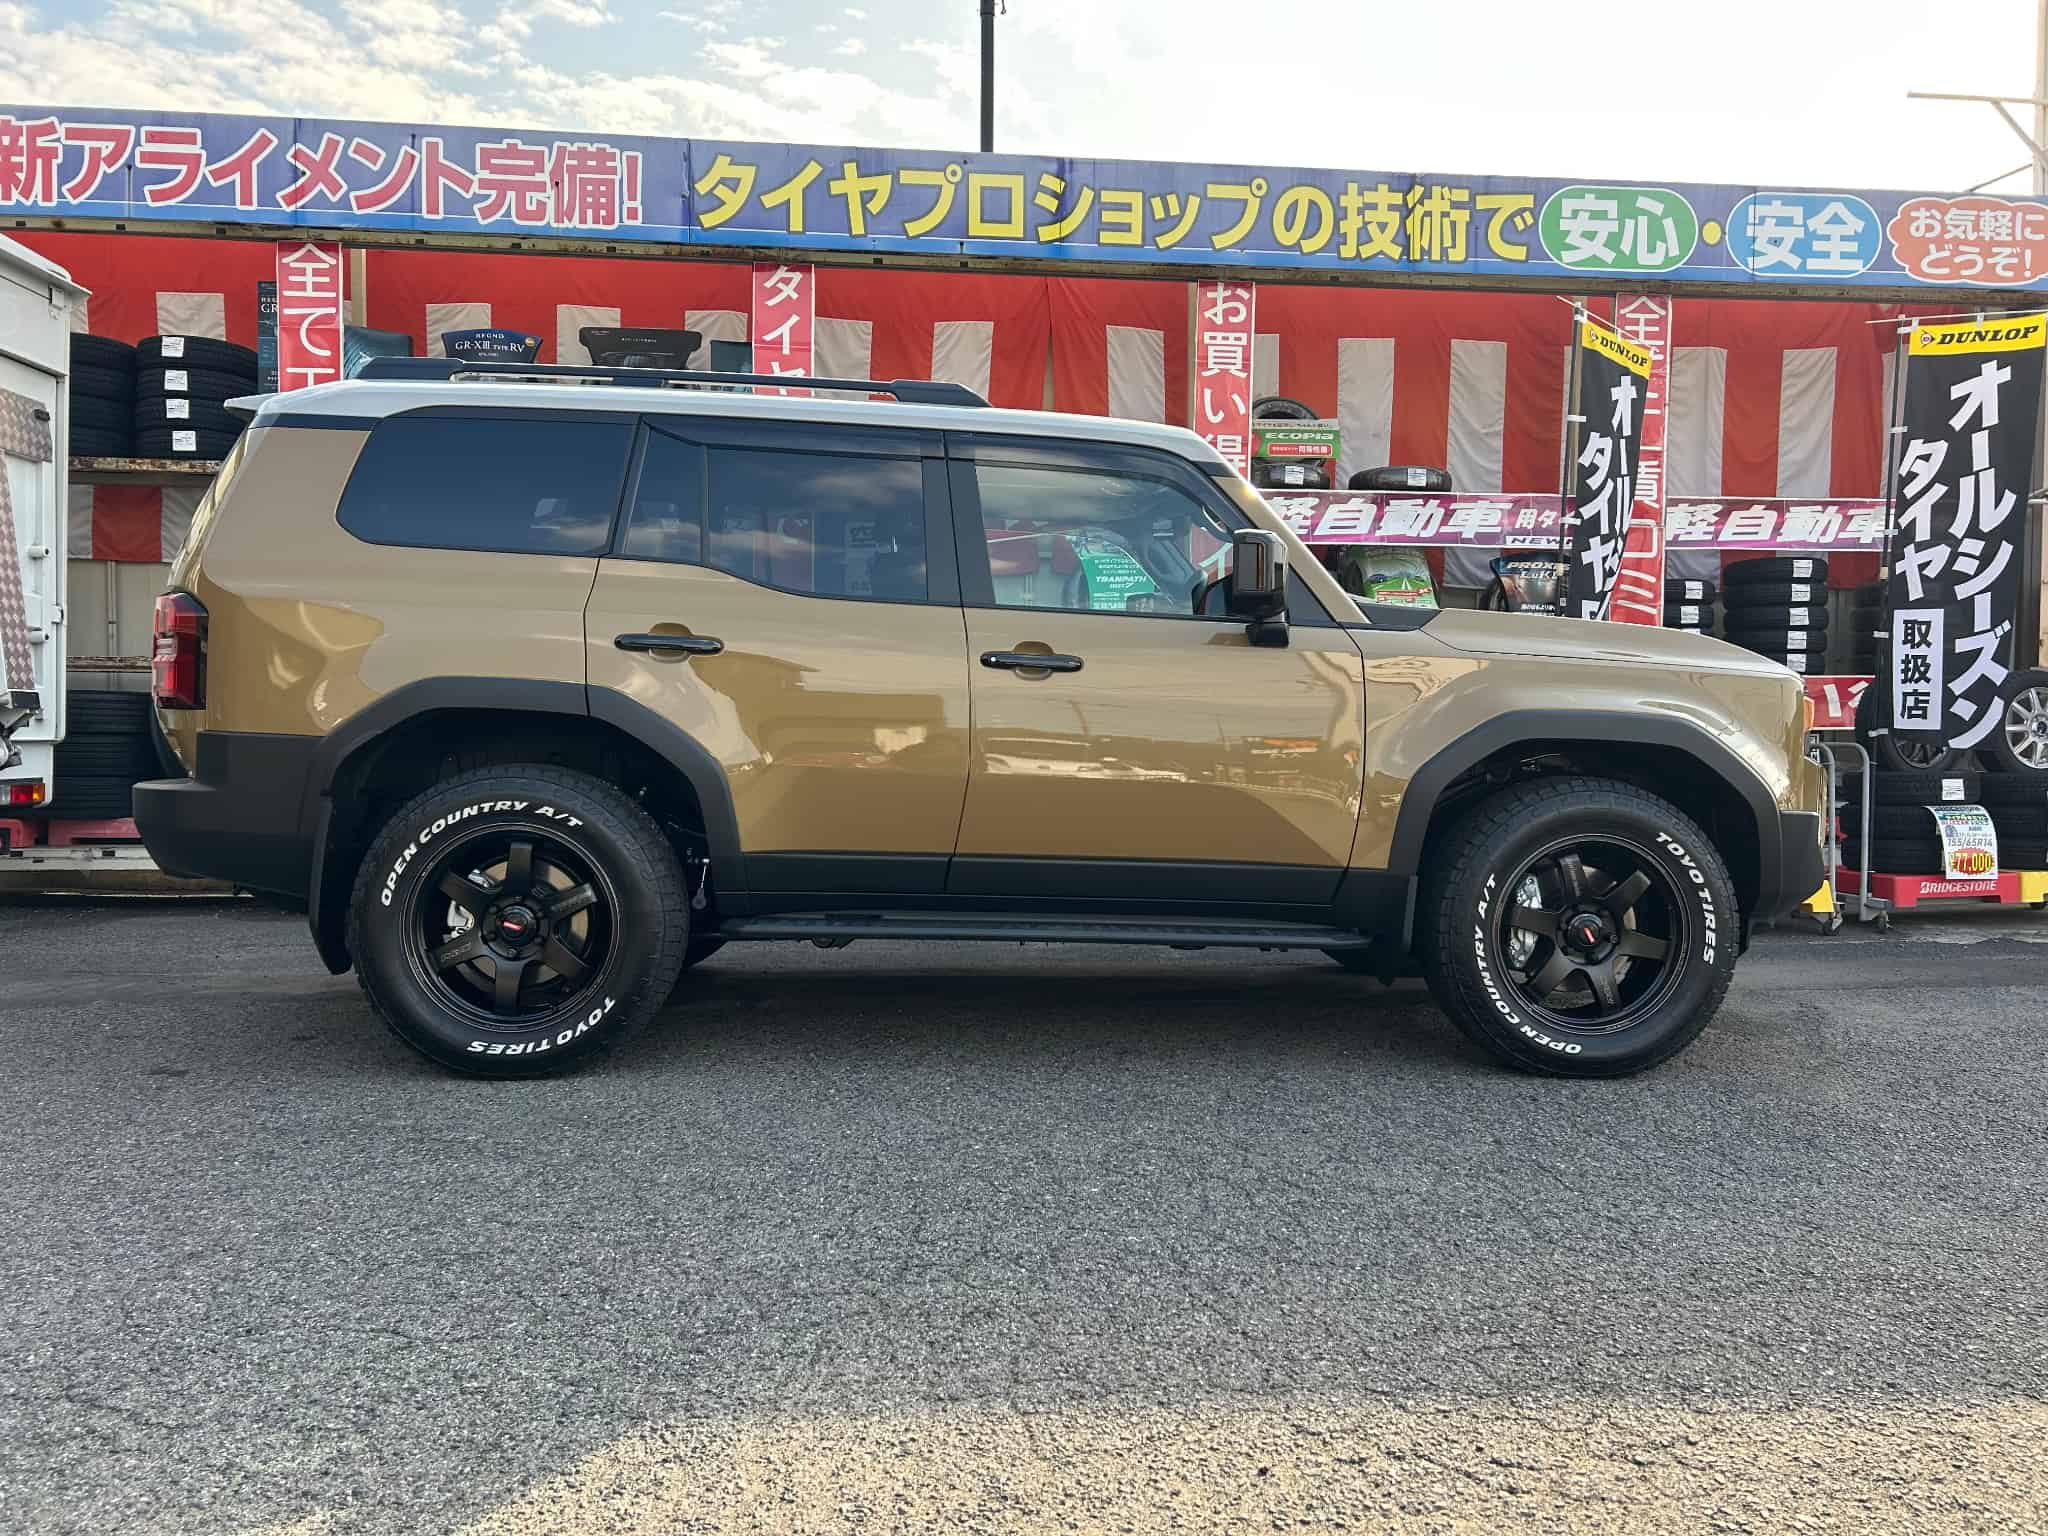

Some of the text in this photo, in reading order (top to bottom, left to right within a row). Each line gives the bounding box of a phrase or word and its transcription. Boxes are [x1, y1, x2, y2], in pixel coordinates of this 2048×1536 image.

[1909, 207, 2046, 241] お気軽に
[1920, 243, 2033, 278] どうぞ!
[1600, 335, 1648, 368] DUNLOP
[1937, 325, 2039, 345] DUNLOP
[1895, 439, 1951, 602] タイヤ
[1947, 360, 2016, 749] オールシーズン
[1900, 618, 1932, 720] 取扱店
[381, 800, 583, 906] OPEN COUNTRY A/T
[1920, 880, 1997, 894] BRIDGESTONE
[1655, 831, 1717, 965] TOYO TIRES
[1473, 873, 1582, 1054] OPEN COUNTRY A/T
[466, 997, 616, 1056] TOYO TIRES
